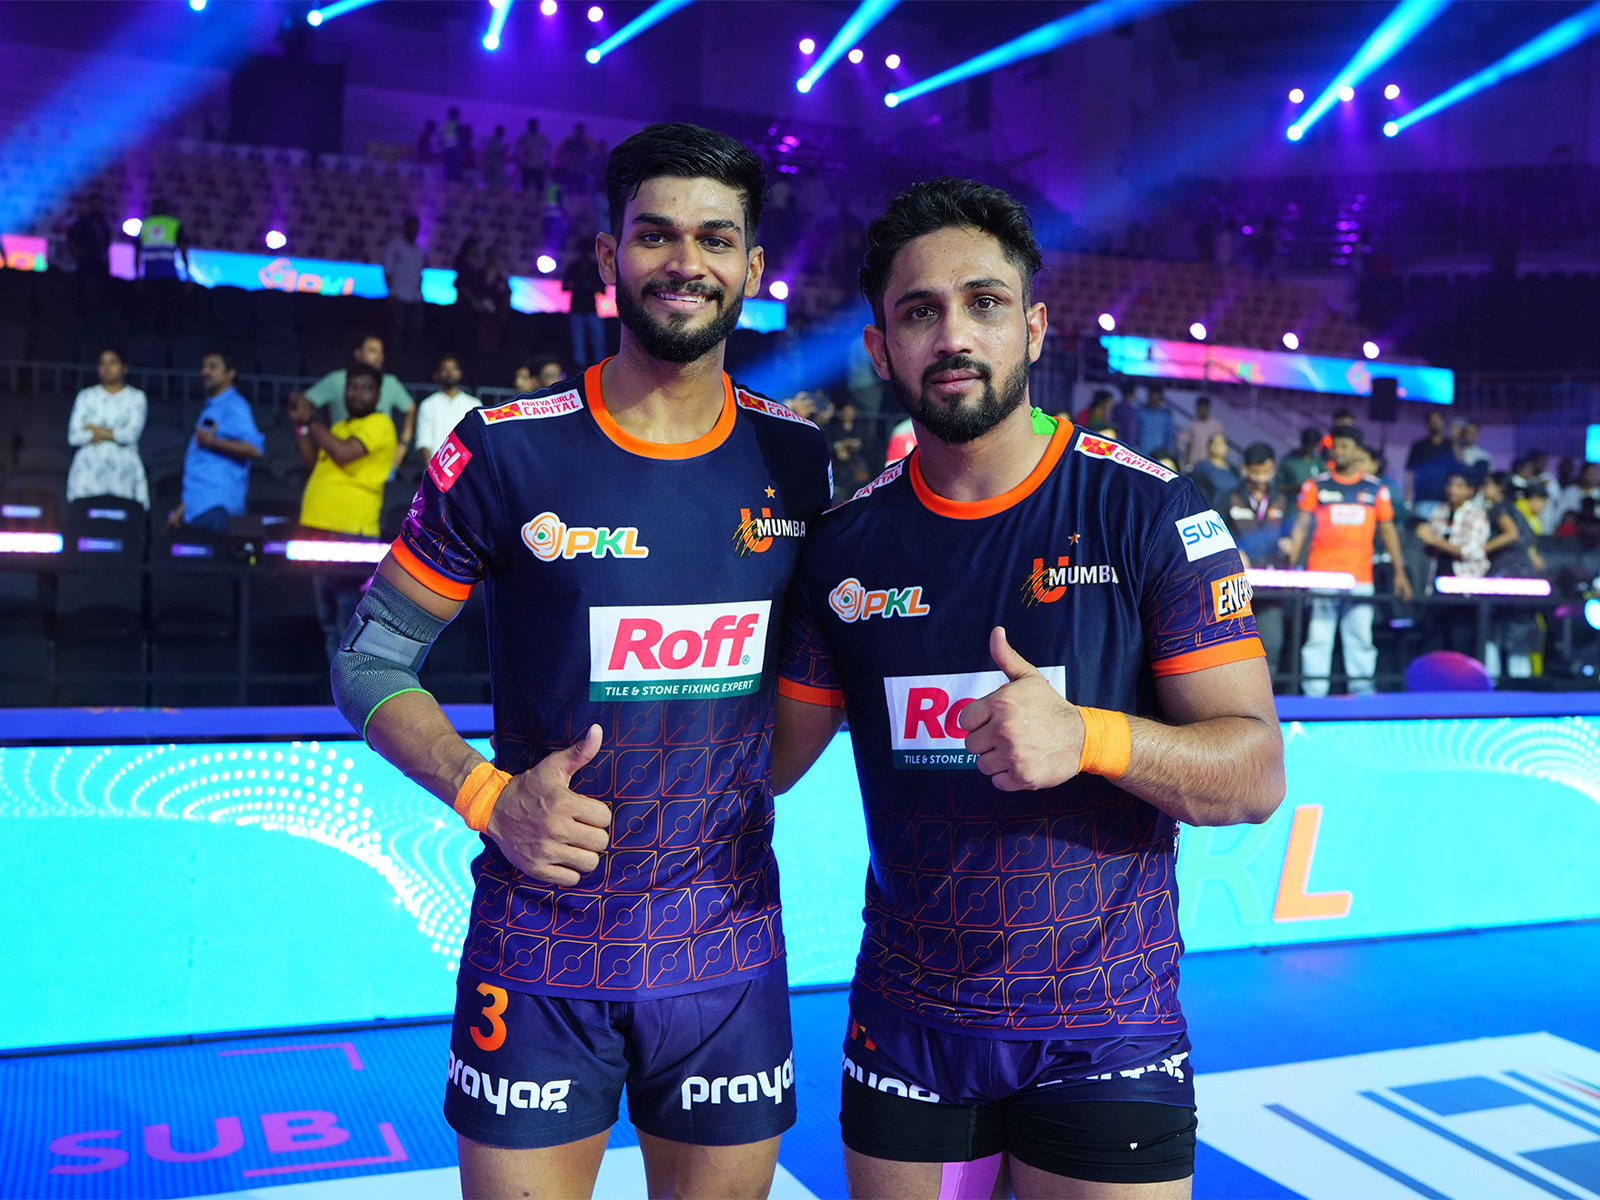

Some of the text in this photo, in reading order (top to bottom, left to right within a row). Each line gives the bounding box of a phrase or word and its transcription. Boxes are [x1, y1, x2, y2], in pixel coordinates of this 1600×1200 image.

[523, 400, 579, 416] CAPITAL
[551, 393, 576, 405] BIRLA
[1114, 452, 1167, 479] CAPITAL
[564, 529, 647, 557] PKL
[862, 588, 930, 618] PKL
[608, 614, 760, 670] Roff
[605, 679, 754, 696] TILE & STONE FIXING EXPERT
[904, 687, 980, 739] Ro
[904, 754, 980, 764] TILE & STONE FI
[470, 981, 508, 1052] 3
[681, 1048, 795, 1111] praya
[48, 1110, 350, 1175] SUB
